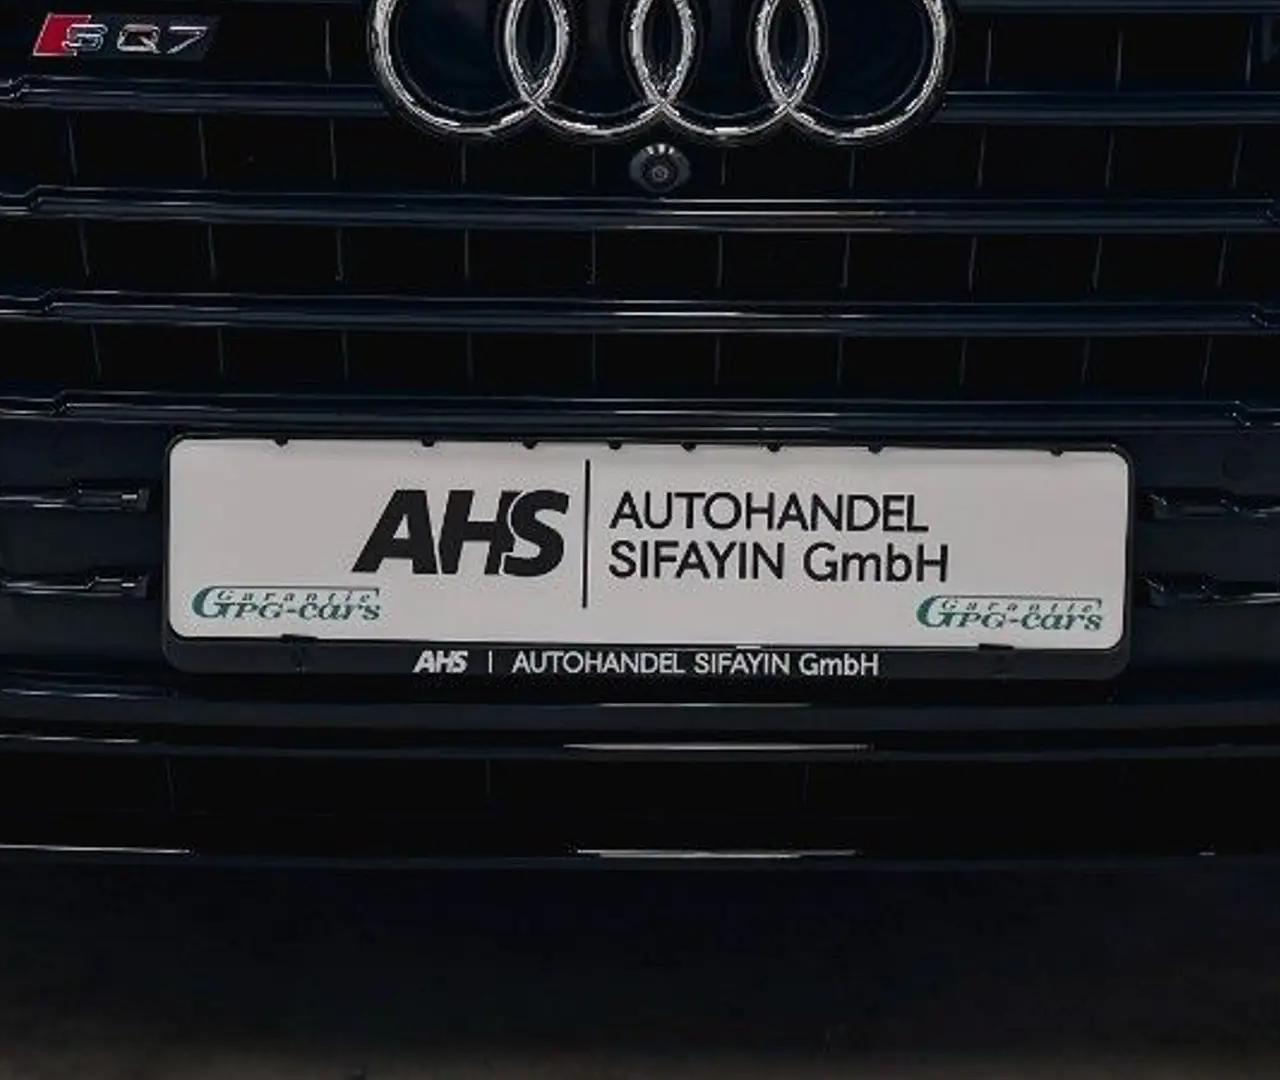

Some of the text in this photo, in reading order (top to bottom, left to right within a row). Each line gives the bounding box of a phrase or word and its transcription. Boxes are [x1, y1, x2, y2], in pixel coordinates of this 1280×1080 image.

[609, 491, 929, 532] AUTOHANDEL
[352, 489, 569, 577] AHS
[608, 539, 949, 582] SIFAYIN GmbH
[218, 589, 371, 603] Garantie
[412, 650, 880, 676] AHS AUTOHANDEL SIFAYIN GmbH
